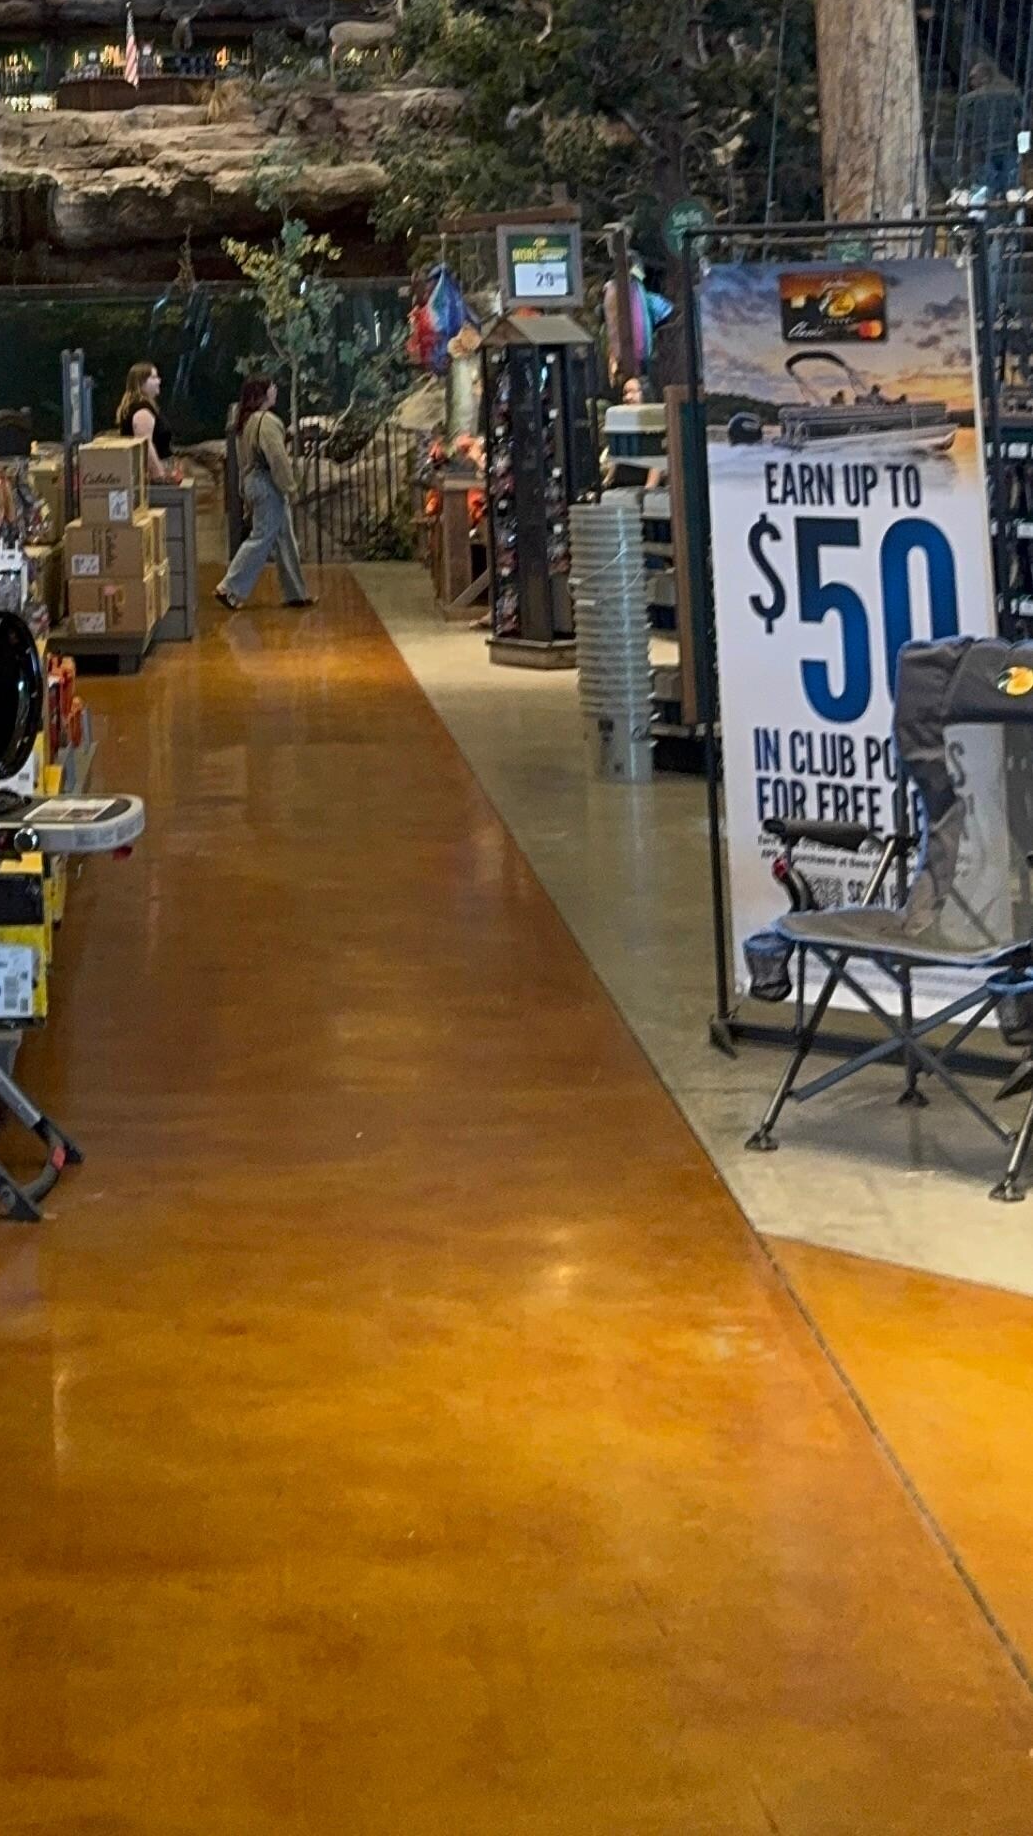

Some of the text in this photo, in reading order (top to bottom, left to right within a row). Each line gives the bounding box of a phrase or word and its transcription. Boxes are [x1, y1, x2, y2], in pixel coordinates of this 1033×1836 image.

[765, 462, 922, 508] EARN UP TO
[748, 512, 960, 725] $50
[754, 727, 781, 773] IN
[788, 730, 856, 779] CLUB
[756, 777, 807, 822] FOR
[816, 782, 884, 832] FREE
